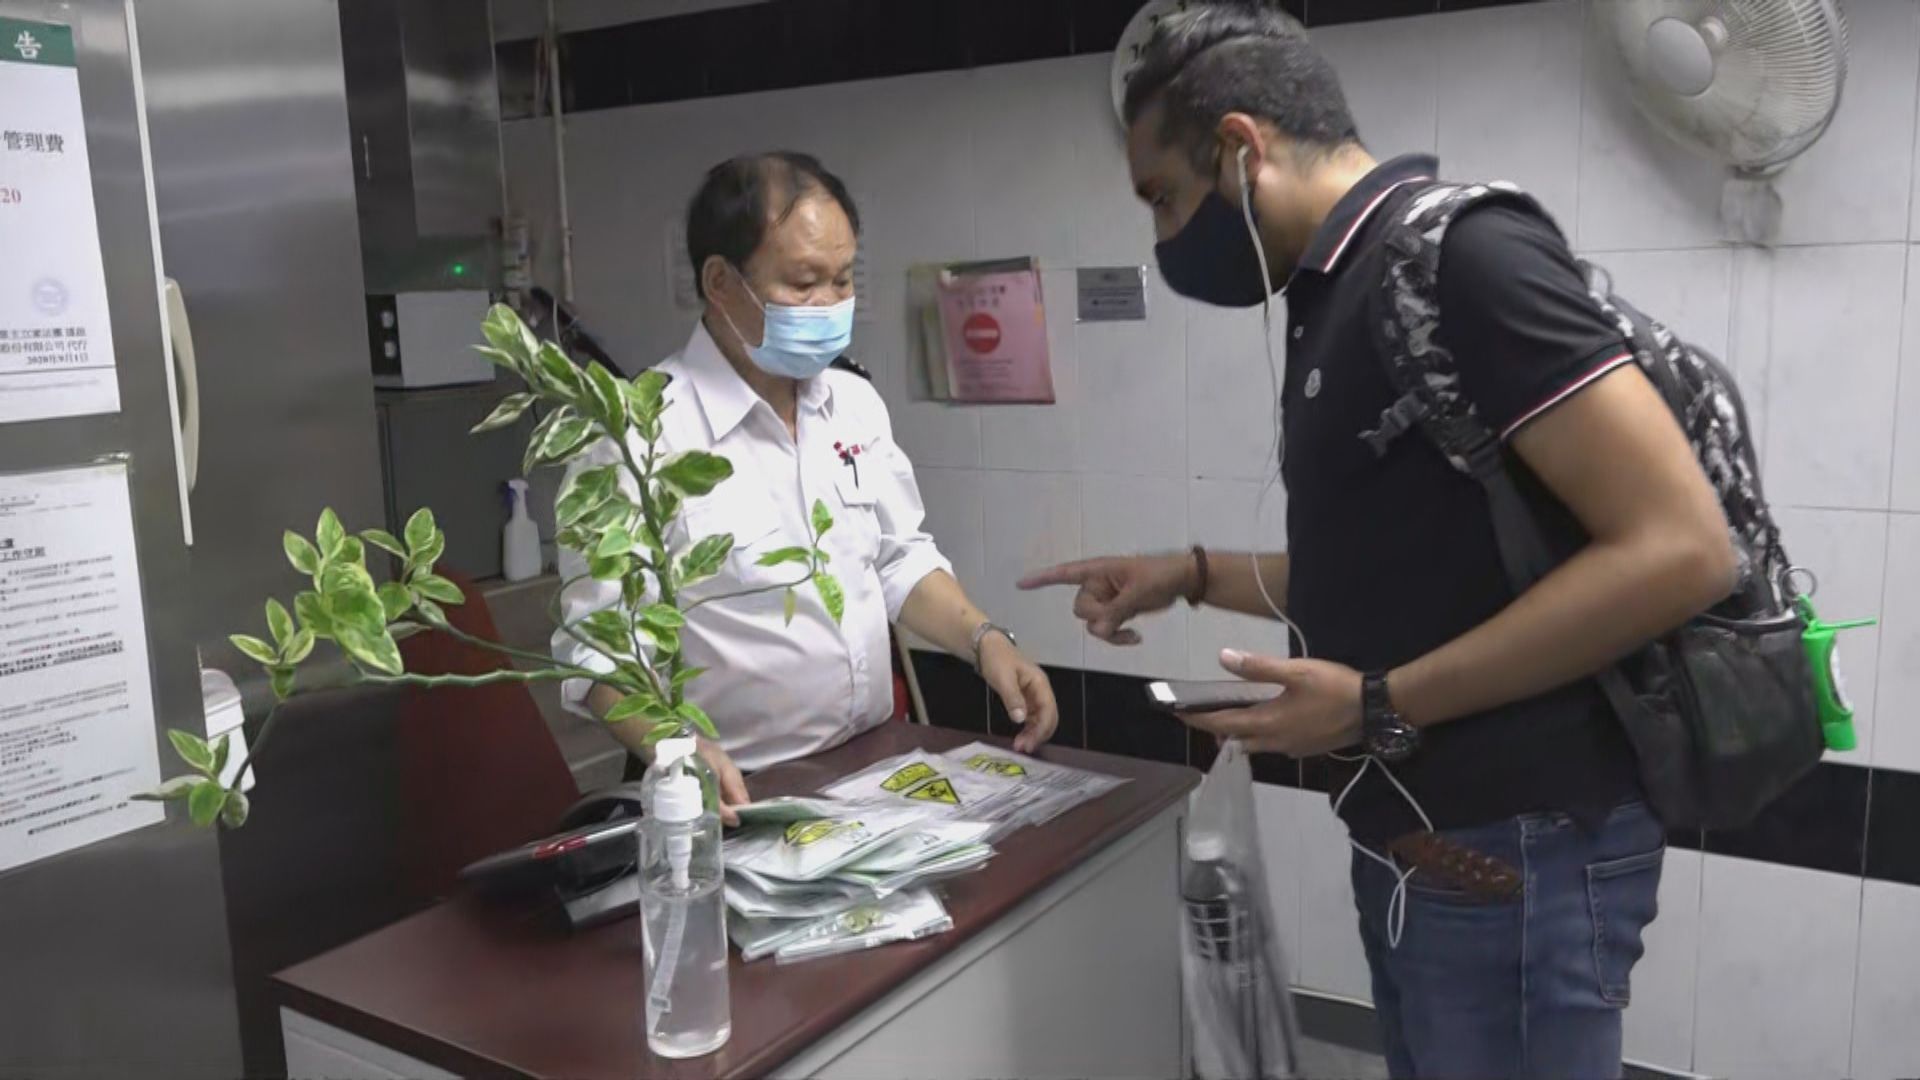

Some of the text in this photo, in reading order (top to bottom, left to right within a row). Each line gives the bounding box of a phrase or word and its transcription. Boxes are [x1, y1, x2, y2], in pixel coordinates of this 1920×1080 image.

[14, 30, 42, 60] 告
[3, 130, 65, 153] 管理費
